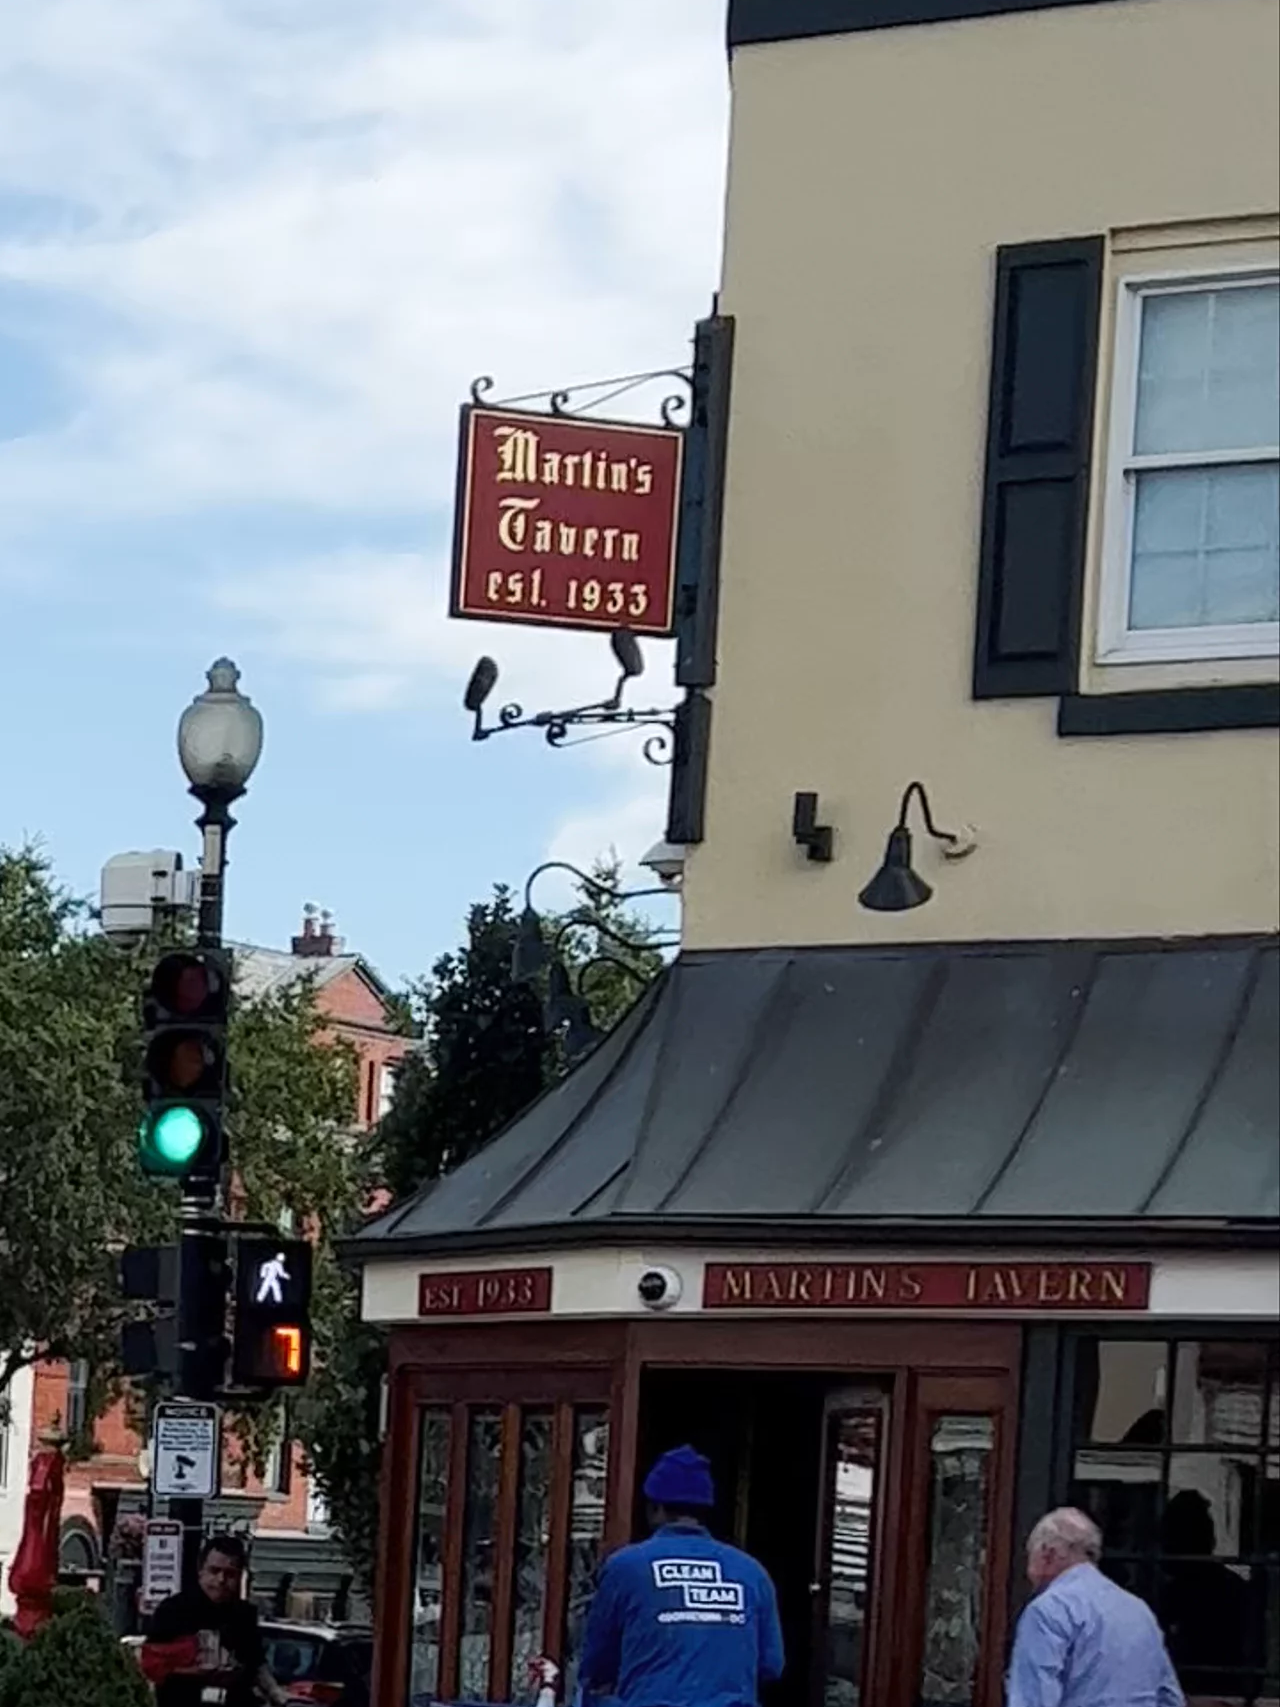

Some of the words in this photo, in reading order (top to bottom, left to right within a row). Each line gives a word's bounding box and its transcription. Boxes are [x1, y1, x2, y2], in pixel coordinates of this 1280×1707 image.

[493, 426, 653, 495] Martin's
[497, 497, 640, 562] Tavern
[486, 568, 547, 607] est.
[566, 578, 649, 615] 1933
[424, 1285, 460, 1309] EST
[477, 1276, 533, 1307] 1933
[966, 1268, 1127, 1301] TAVERN
[661, 1564, 714, 1580] CLEAN
[689, 1587, 737, 1602] TEAM
